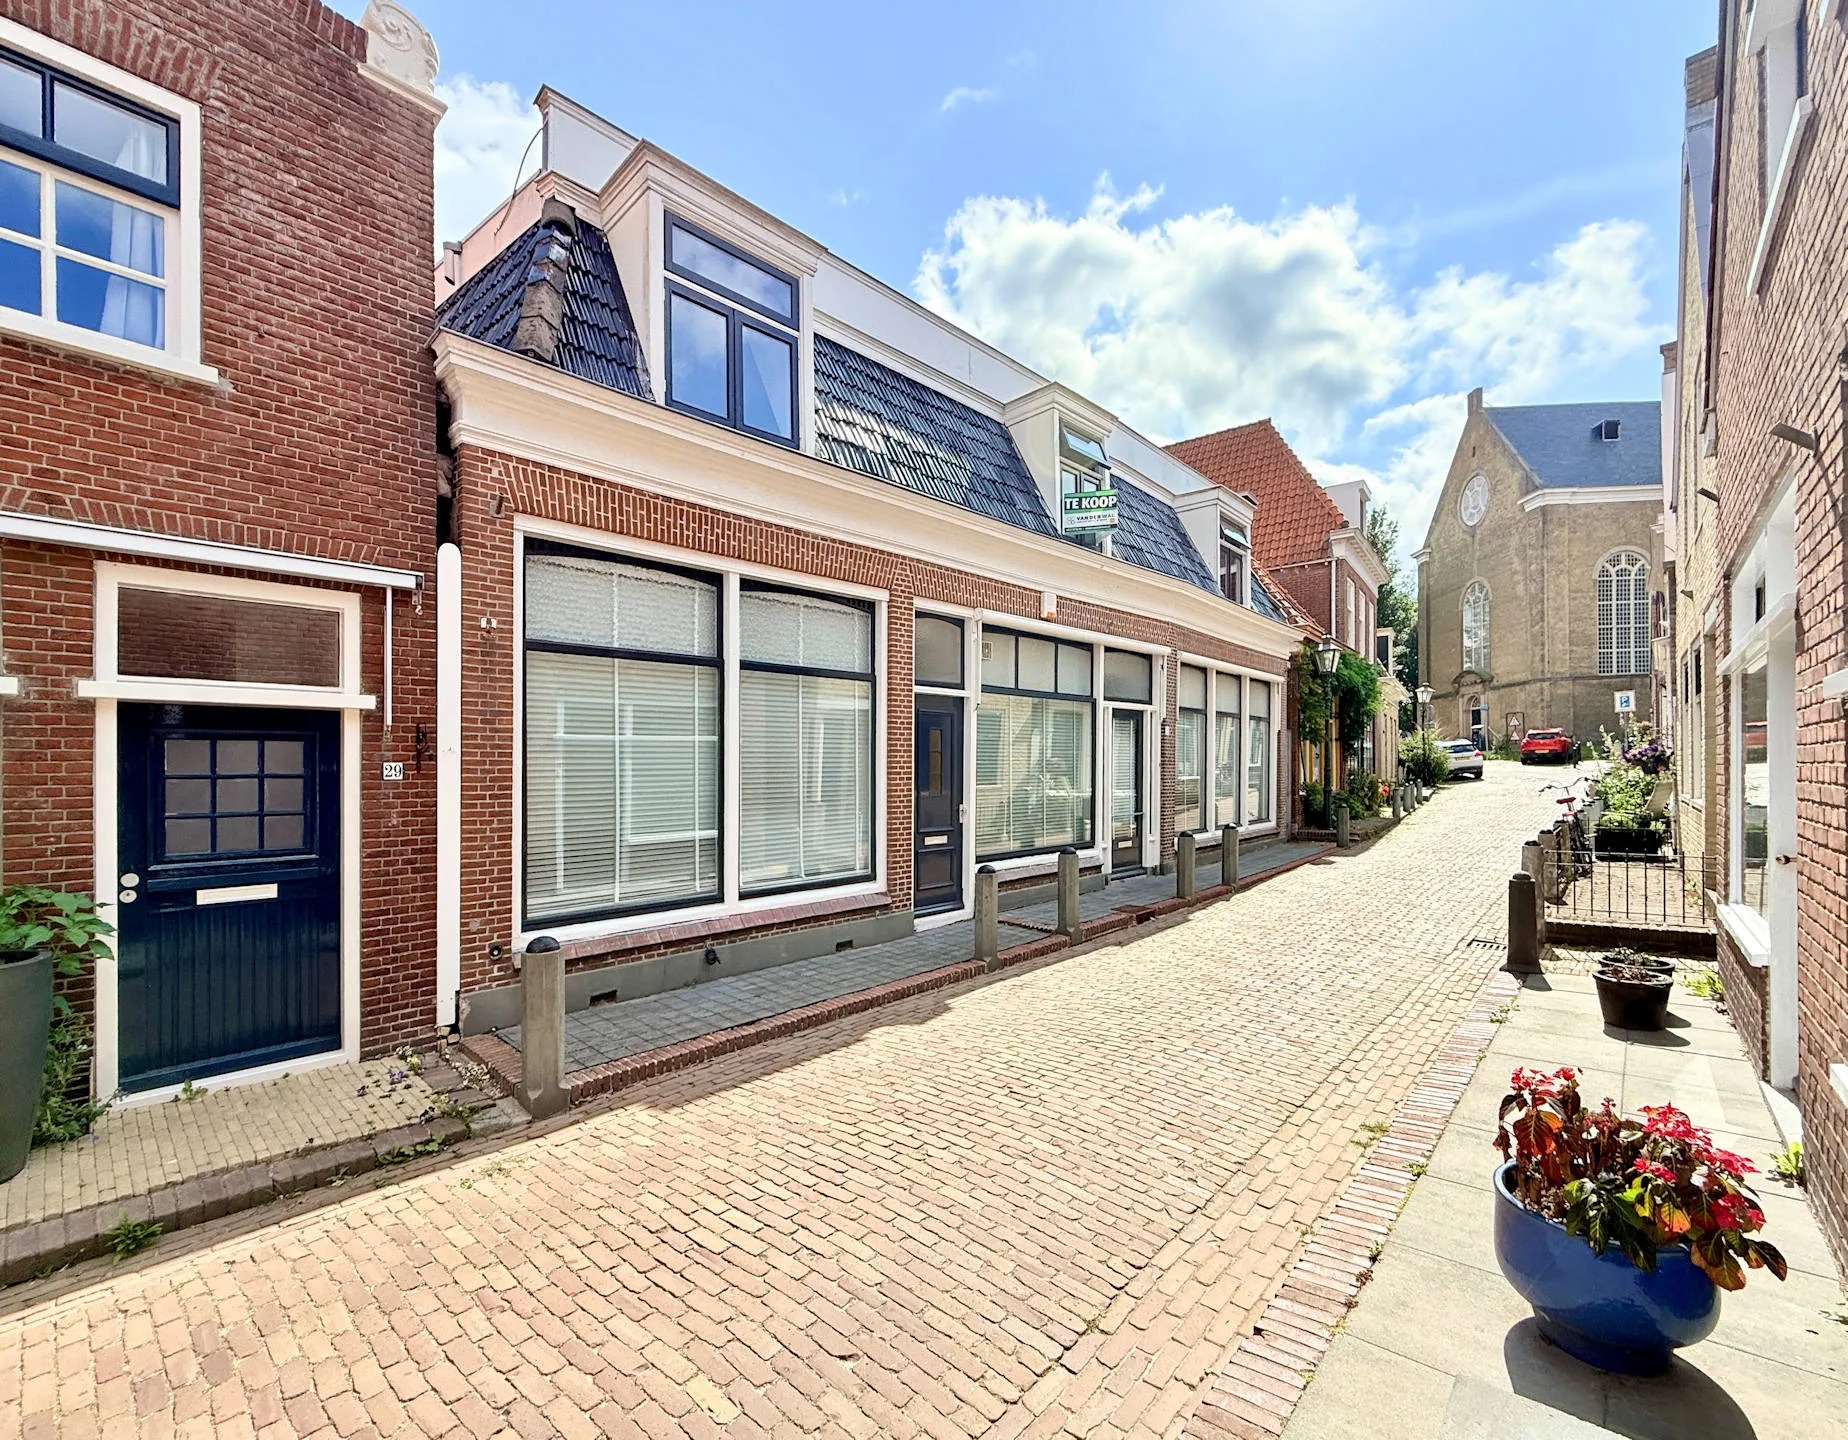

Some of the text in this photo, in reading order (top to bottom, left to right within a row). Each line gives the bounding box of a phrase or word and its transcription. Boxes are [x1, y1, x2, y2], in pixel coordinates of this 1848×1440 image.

[1065, 496, 1117, 509] TE KOOP
[385, 764, 402, 778] 29
